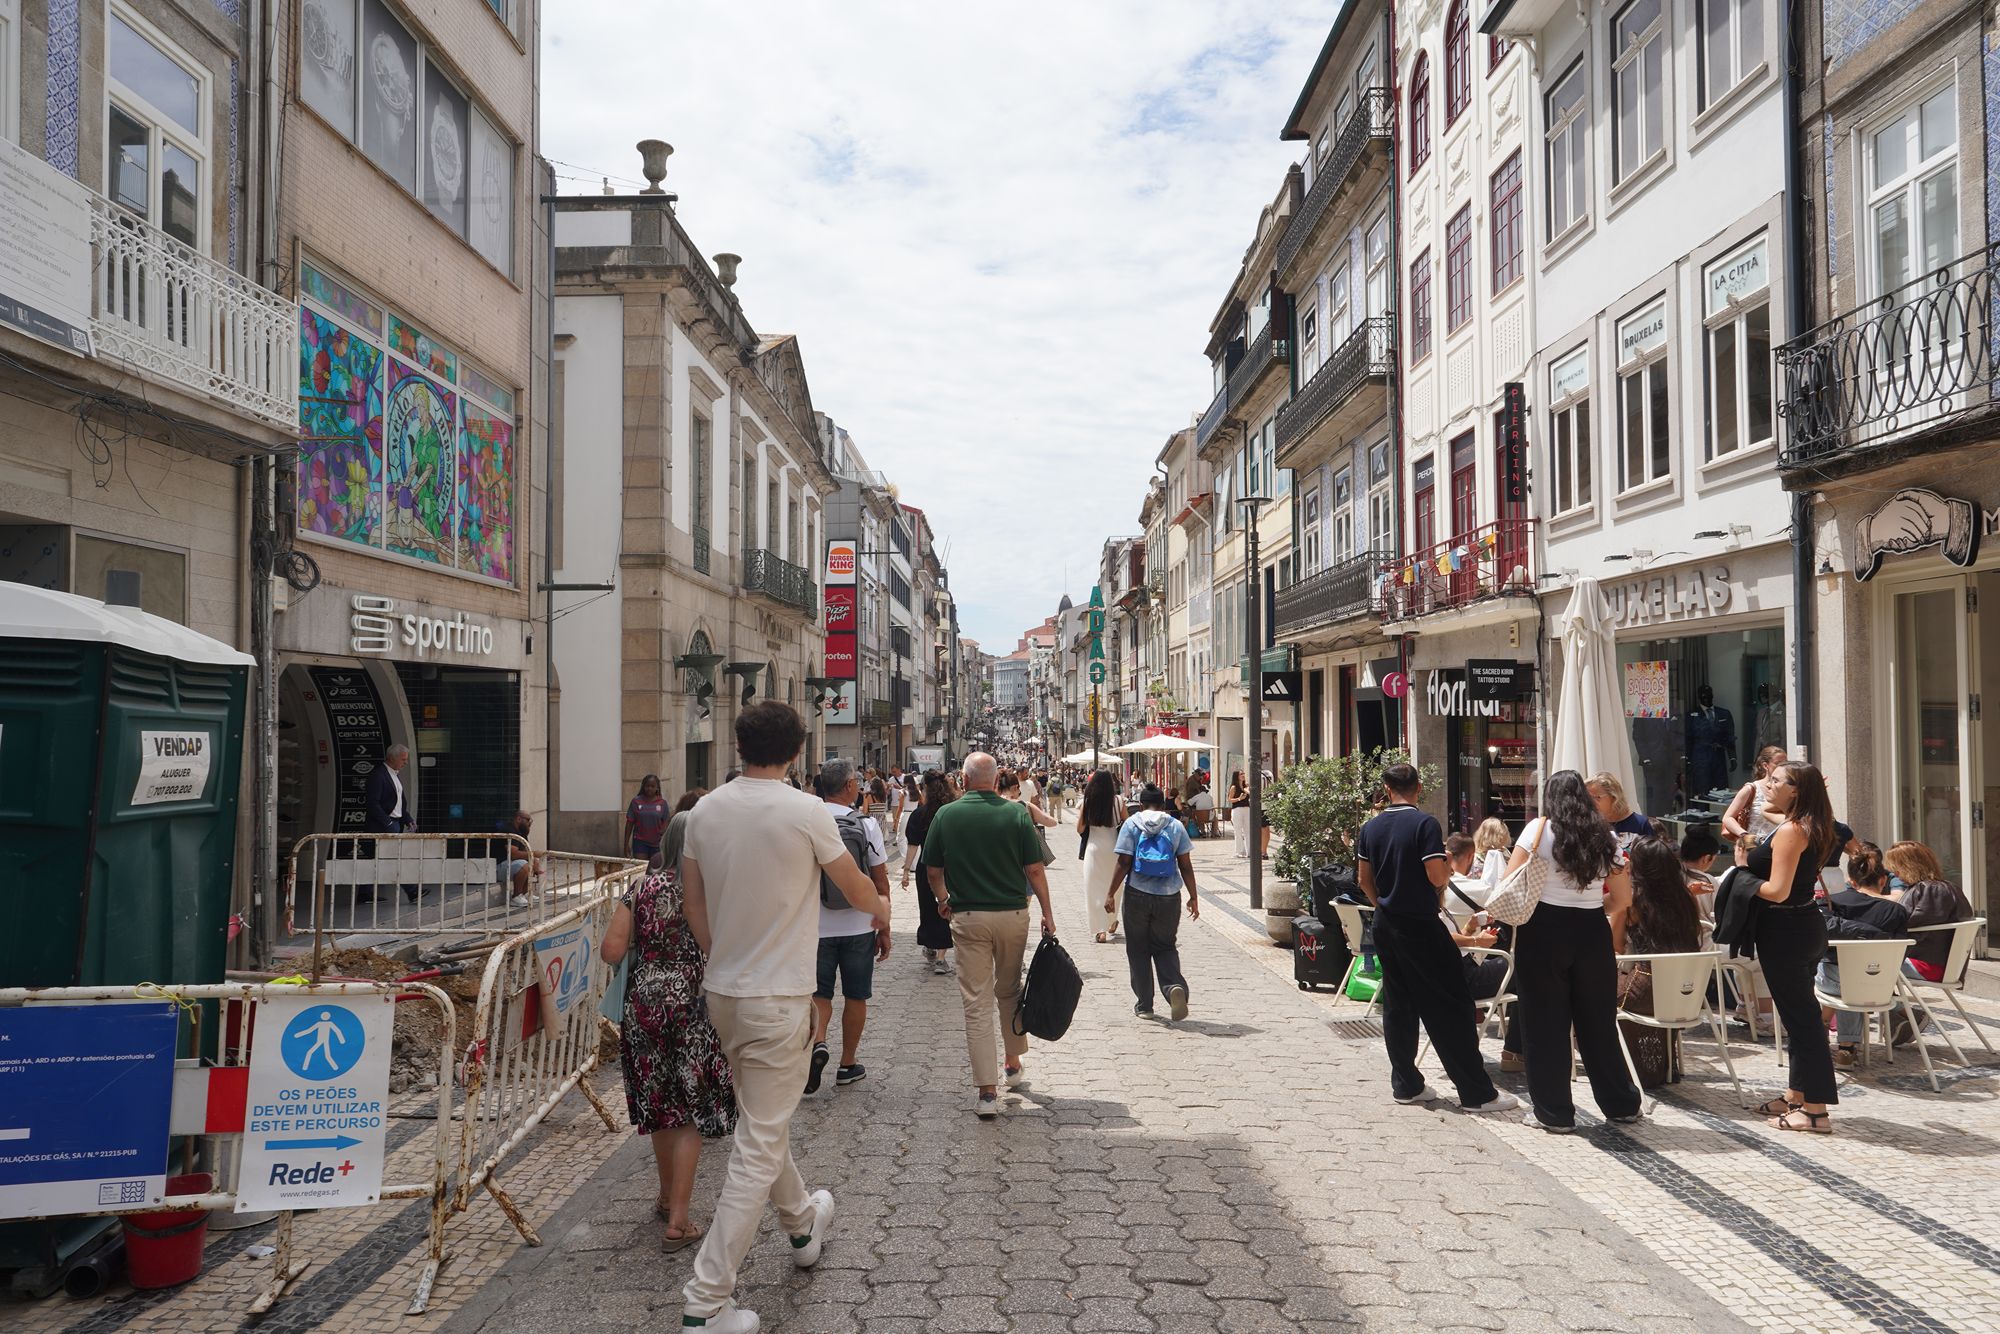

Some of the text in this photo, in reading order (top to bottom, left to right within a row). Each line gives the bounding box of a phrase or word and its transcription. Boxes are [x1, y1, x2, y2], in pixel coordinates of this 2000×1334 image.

[1715, 275, 1726, 290] LA
[1624, 319, 1663, 349] BRUXELAS
[1511, 388, 1521, 496] PIERCING
[829, 561, 854, 569] KING
[828, 611, 847, 624] Hut
[402, 611, 493, 657] sportino
[1628, 677, 1665, 695] SALDOS
[337, 716, 376, 726] BOSS
[154, 737, 202, 757] VENDAP
[161, 768, 191, 778] ALUGUER
[153, 785, 193, 796] 707 202 202
[82, 1054, 115, 1062] extensões
[116, 1053, 145, 1061] pontuais
[280, 1086, 357, 1100] OS PEÕES
[253, 1102, 380, 1117] DEVEM UTILIZAR
[250, 1117, 380, 1132] ESTE PERCURSO
[53, 1151, 71, 1160] GÁS,
[100, 1149, 137, 1158] 21215-PUB
[280, 1188, 340, 1198] www.redegas.pt
